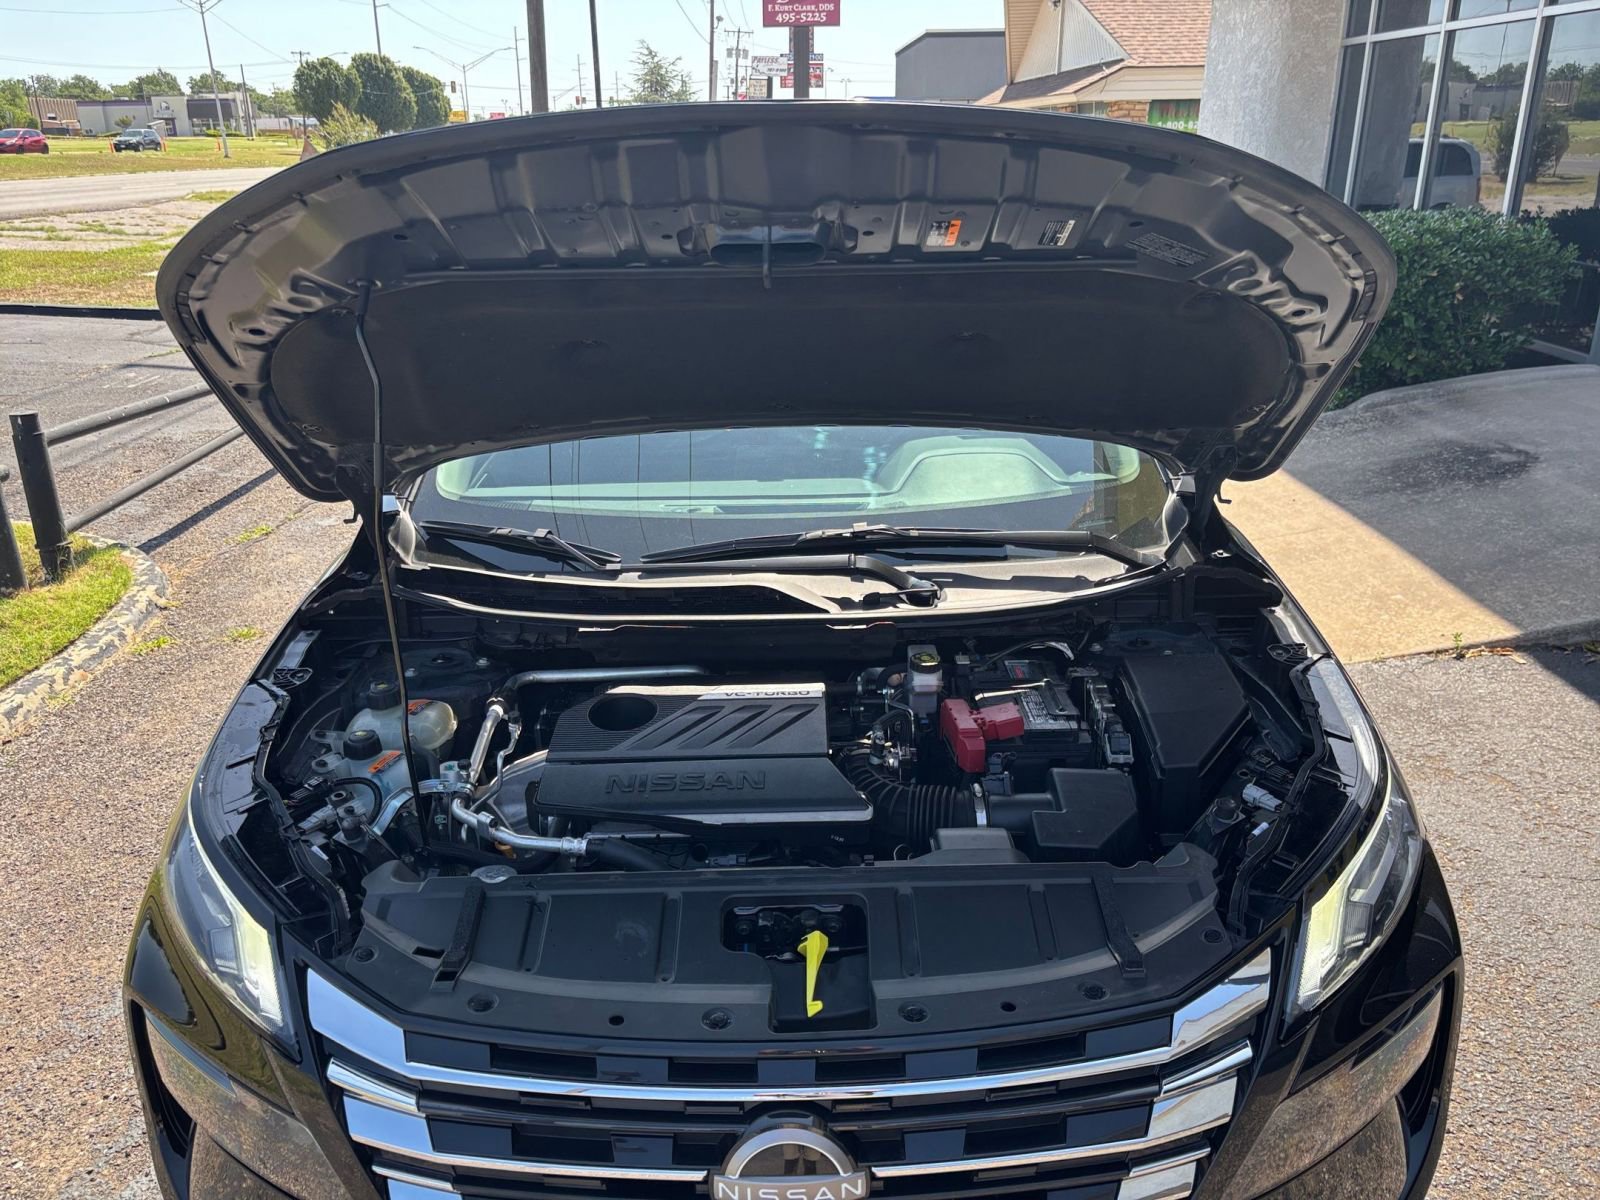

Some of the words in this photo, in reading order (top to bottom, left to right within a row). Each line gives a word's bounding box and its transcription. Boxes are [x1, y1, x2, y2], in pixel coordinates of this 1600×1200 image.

[776, 12, 827, 23] 495-5225
[605, 771, 767, 793] NISSAN
[717, 1178, 863, 1200] NISSAN
